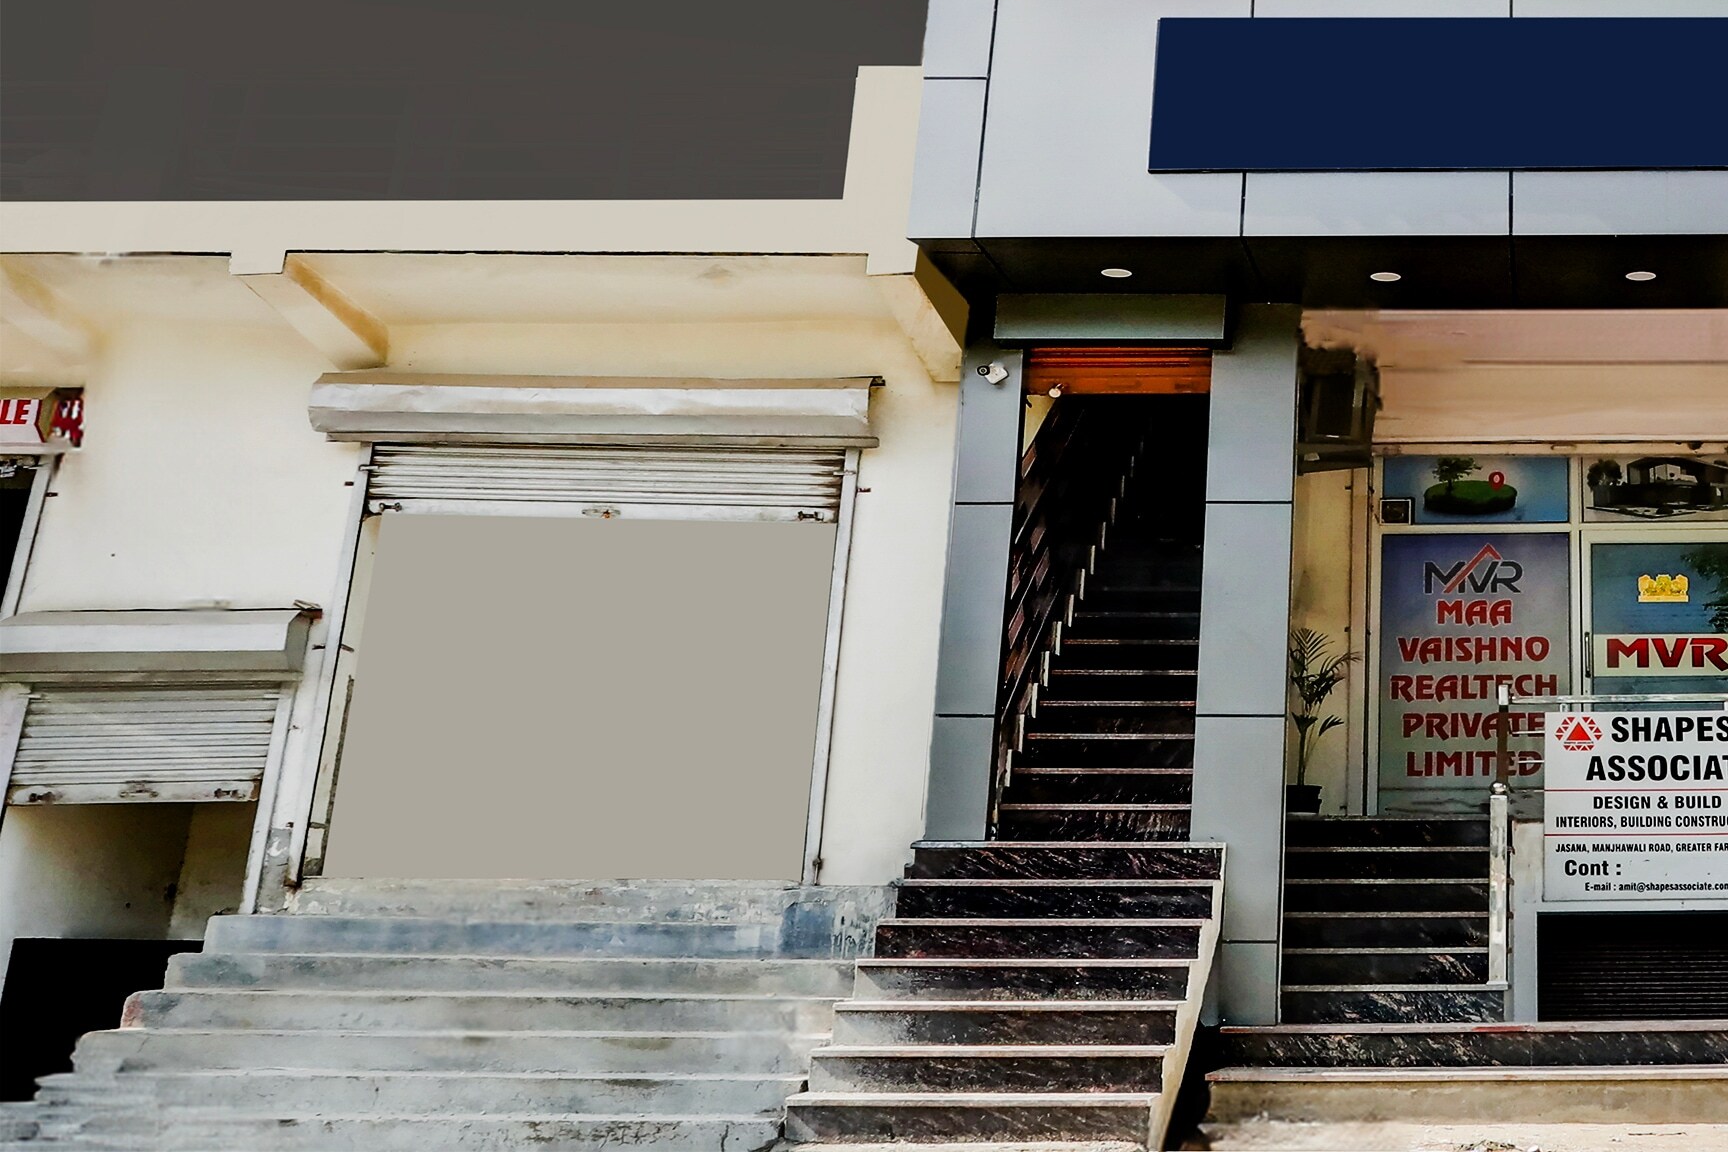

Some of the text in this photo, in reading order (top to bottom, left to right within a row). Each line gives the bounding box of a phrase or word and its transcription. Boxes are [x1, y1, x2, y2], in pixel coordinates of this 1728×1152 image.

[1423, 543, 1523, 594] MVR
[1436, 599, 1513, 627] MAA
[1397, 636, 1551, 664] VAISHNO
[1390, 674, 1558, 703] REALTECH
[1402, 712, 1545, 741] PRIVATE
[1593, 796, 1723, 809] DESIGN & BUILD
[1555, 816, 1618, 829] INTERIORS,
[1620, 816, 1672, 828] BUILDING
[1555, 843, 1590, 854] JASANA,
[1592, 843, 1647, 853] MANJHAWALI
[1648, 842, 1674, 853] ROAD,
[1675, 842, 1712, 852] GREATER
[1564, 859, 1610, 877] Cont
[1584, 882, 1612, 892] E-mail
